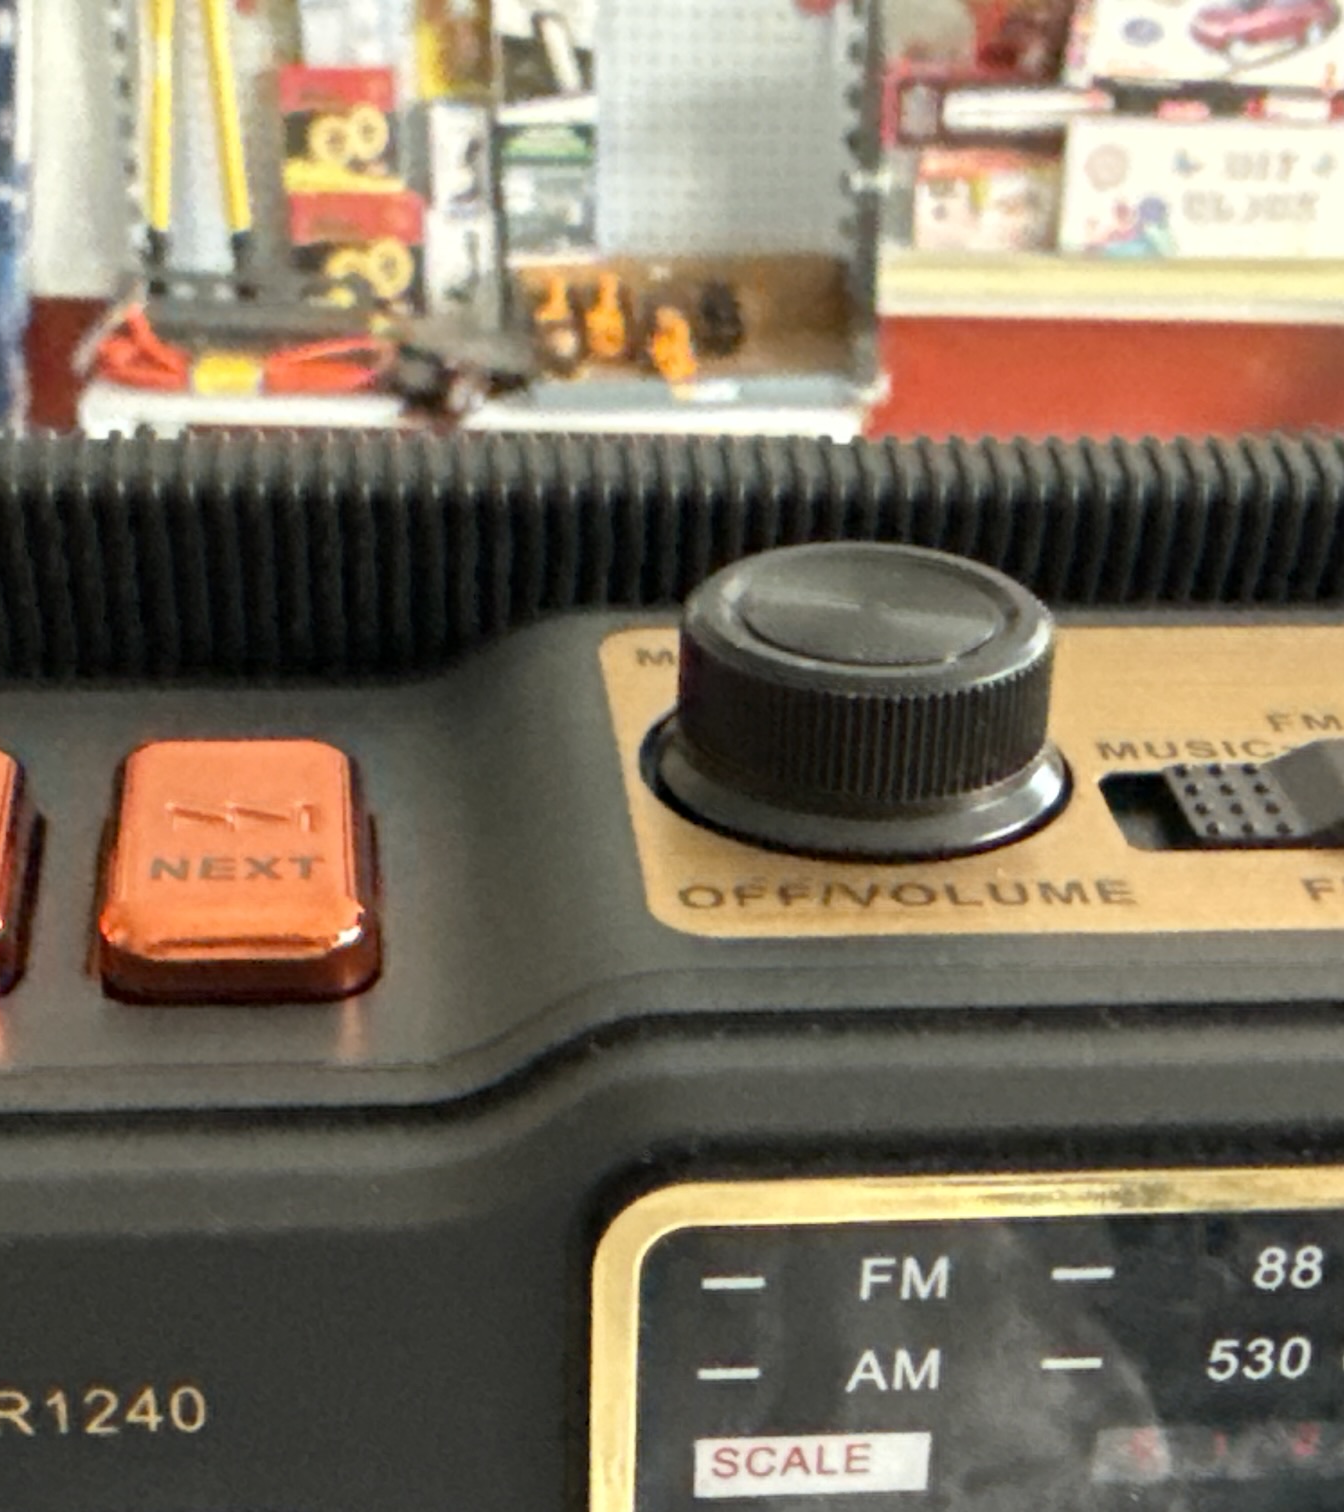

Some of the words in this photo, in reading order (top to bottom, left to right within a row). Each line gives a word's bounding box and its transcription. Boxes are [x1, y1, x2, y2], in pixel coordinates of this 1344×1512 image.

[1264, 712, 1343, 732] FM
[147, 855, 326, 881] NEXT
[678, 877, 1140, 910] OFF/VOLUME
[859, 1256, 950, 1301] FM
[1253, 1245, 1324, 1291] 88
[845, 1348, 941, 1393] AM
[1207, 1336, 1312, 1382] 530
[710, 1442, 873, 1479] SCALE
